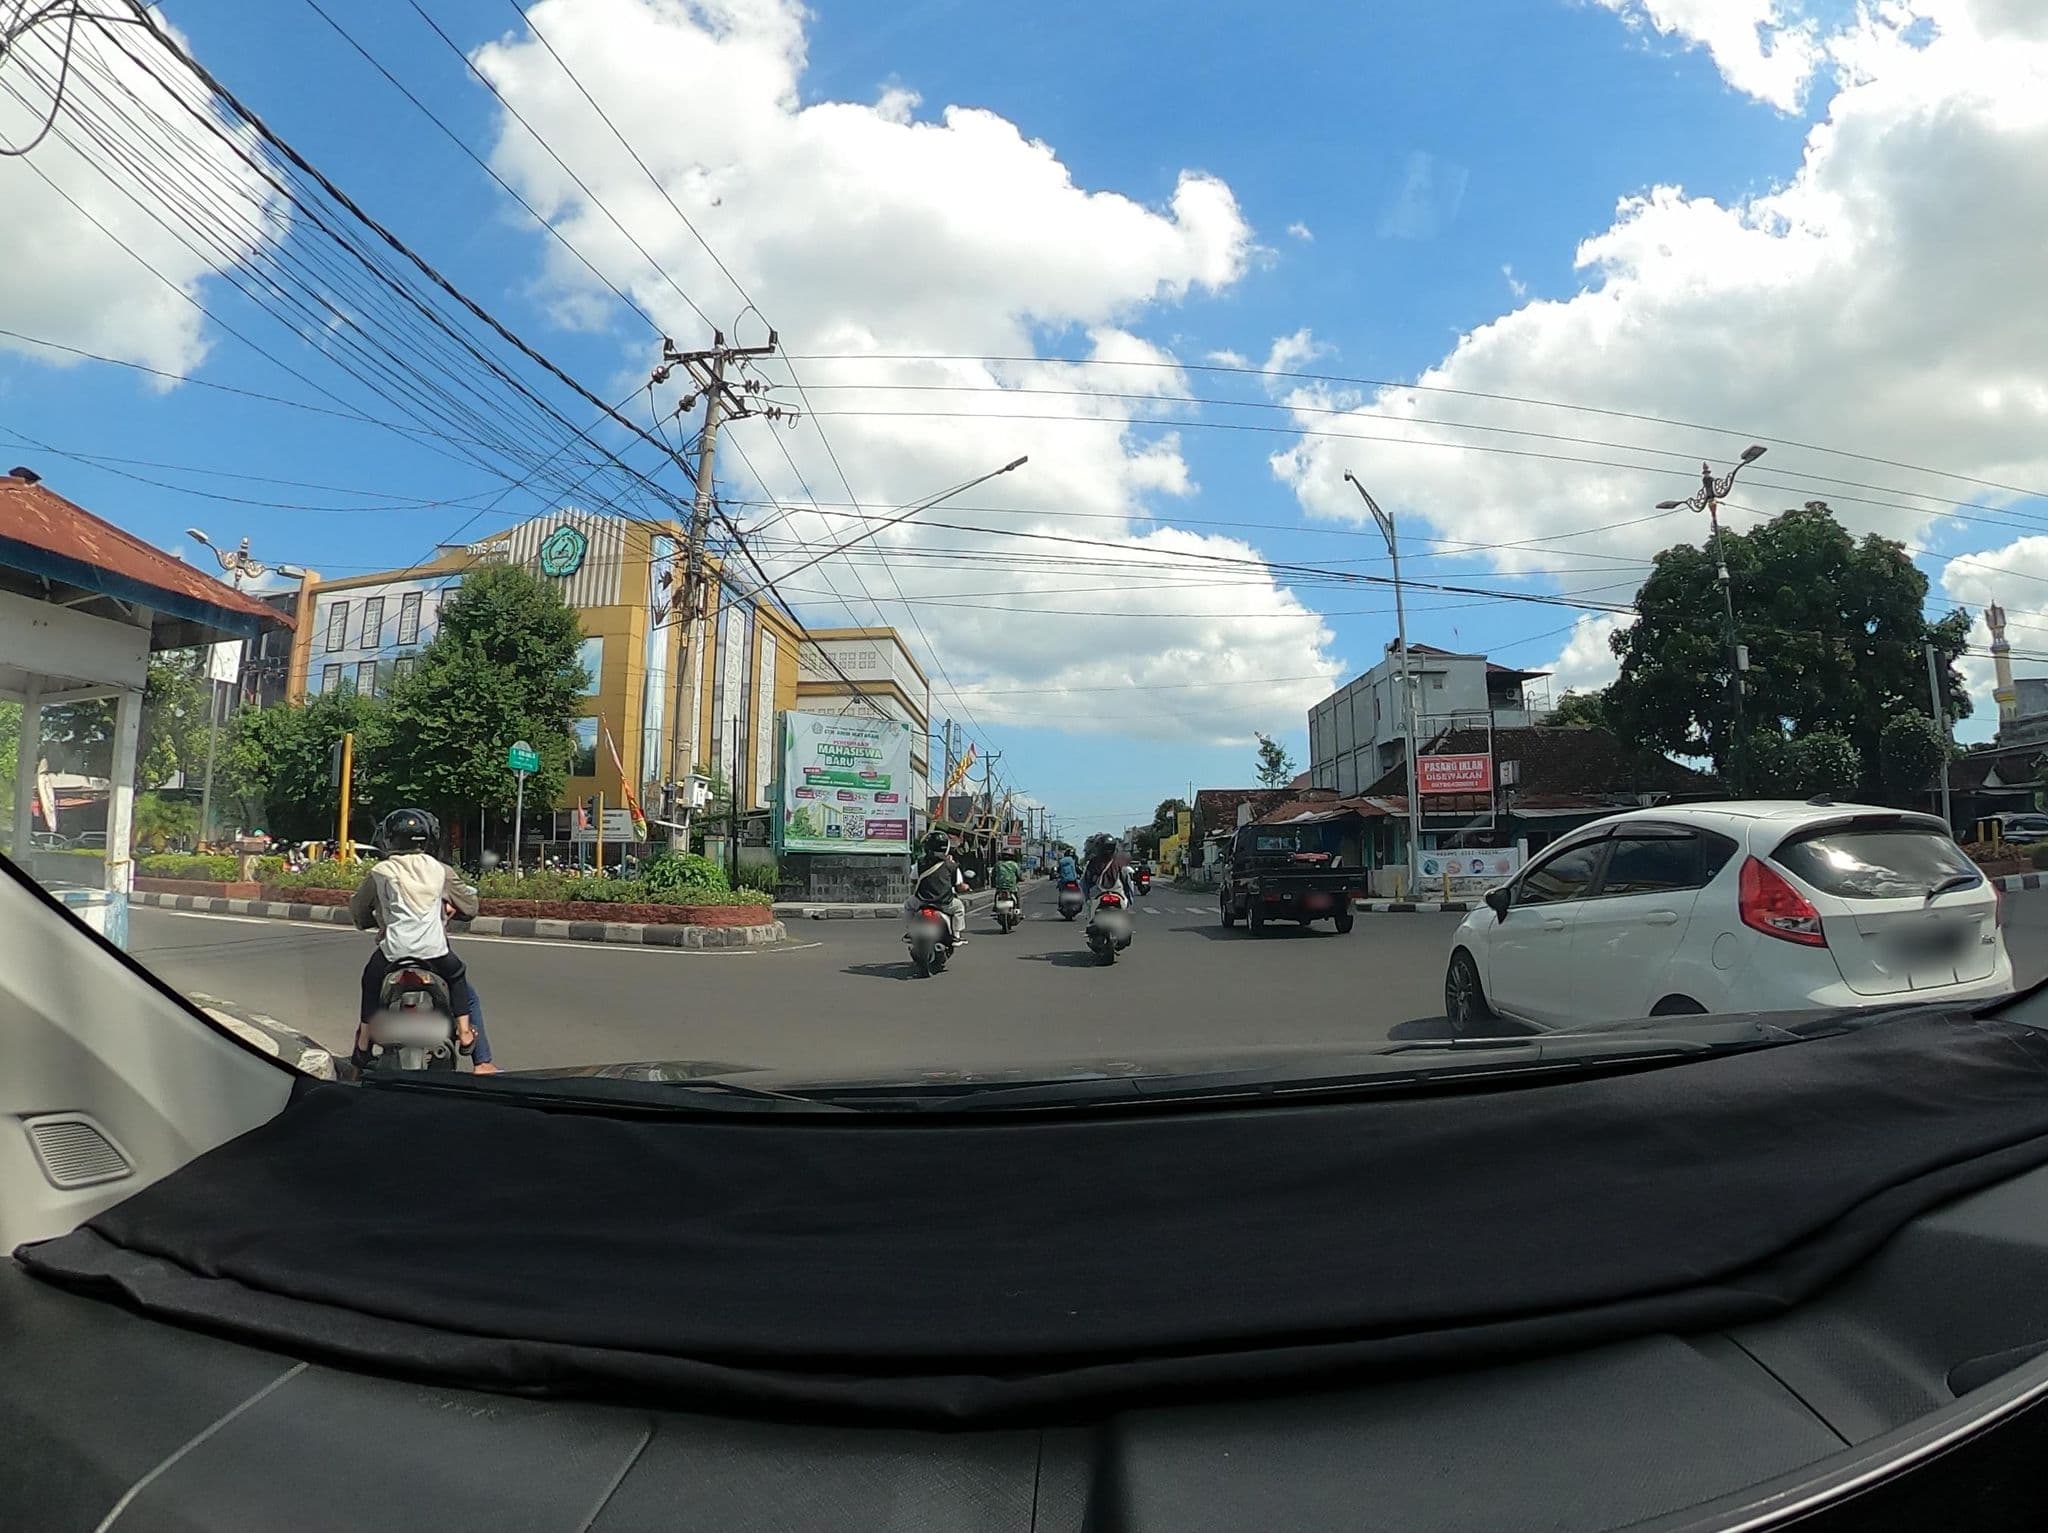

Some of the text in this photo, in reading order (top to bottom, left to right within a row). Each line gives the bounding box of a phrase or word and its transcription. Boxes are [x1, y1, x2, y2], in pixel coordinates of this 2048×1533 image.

[818, 744, 882, 758] MAHASISWA
[825, 756, 854, 767] BARU
[1424, 760, 1483, 772] PASANG IKLAN
[1426, 770, 1482, 780] DISEWAKAN
